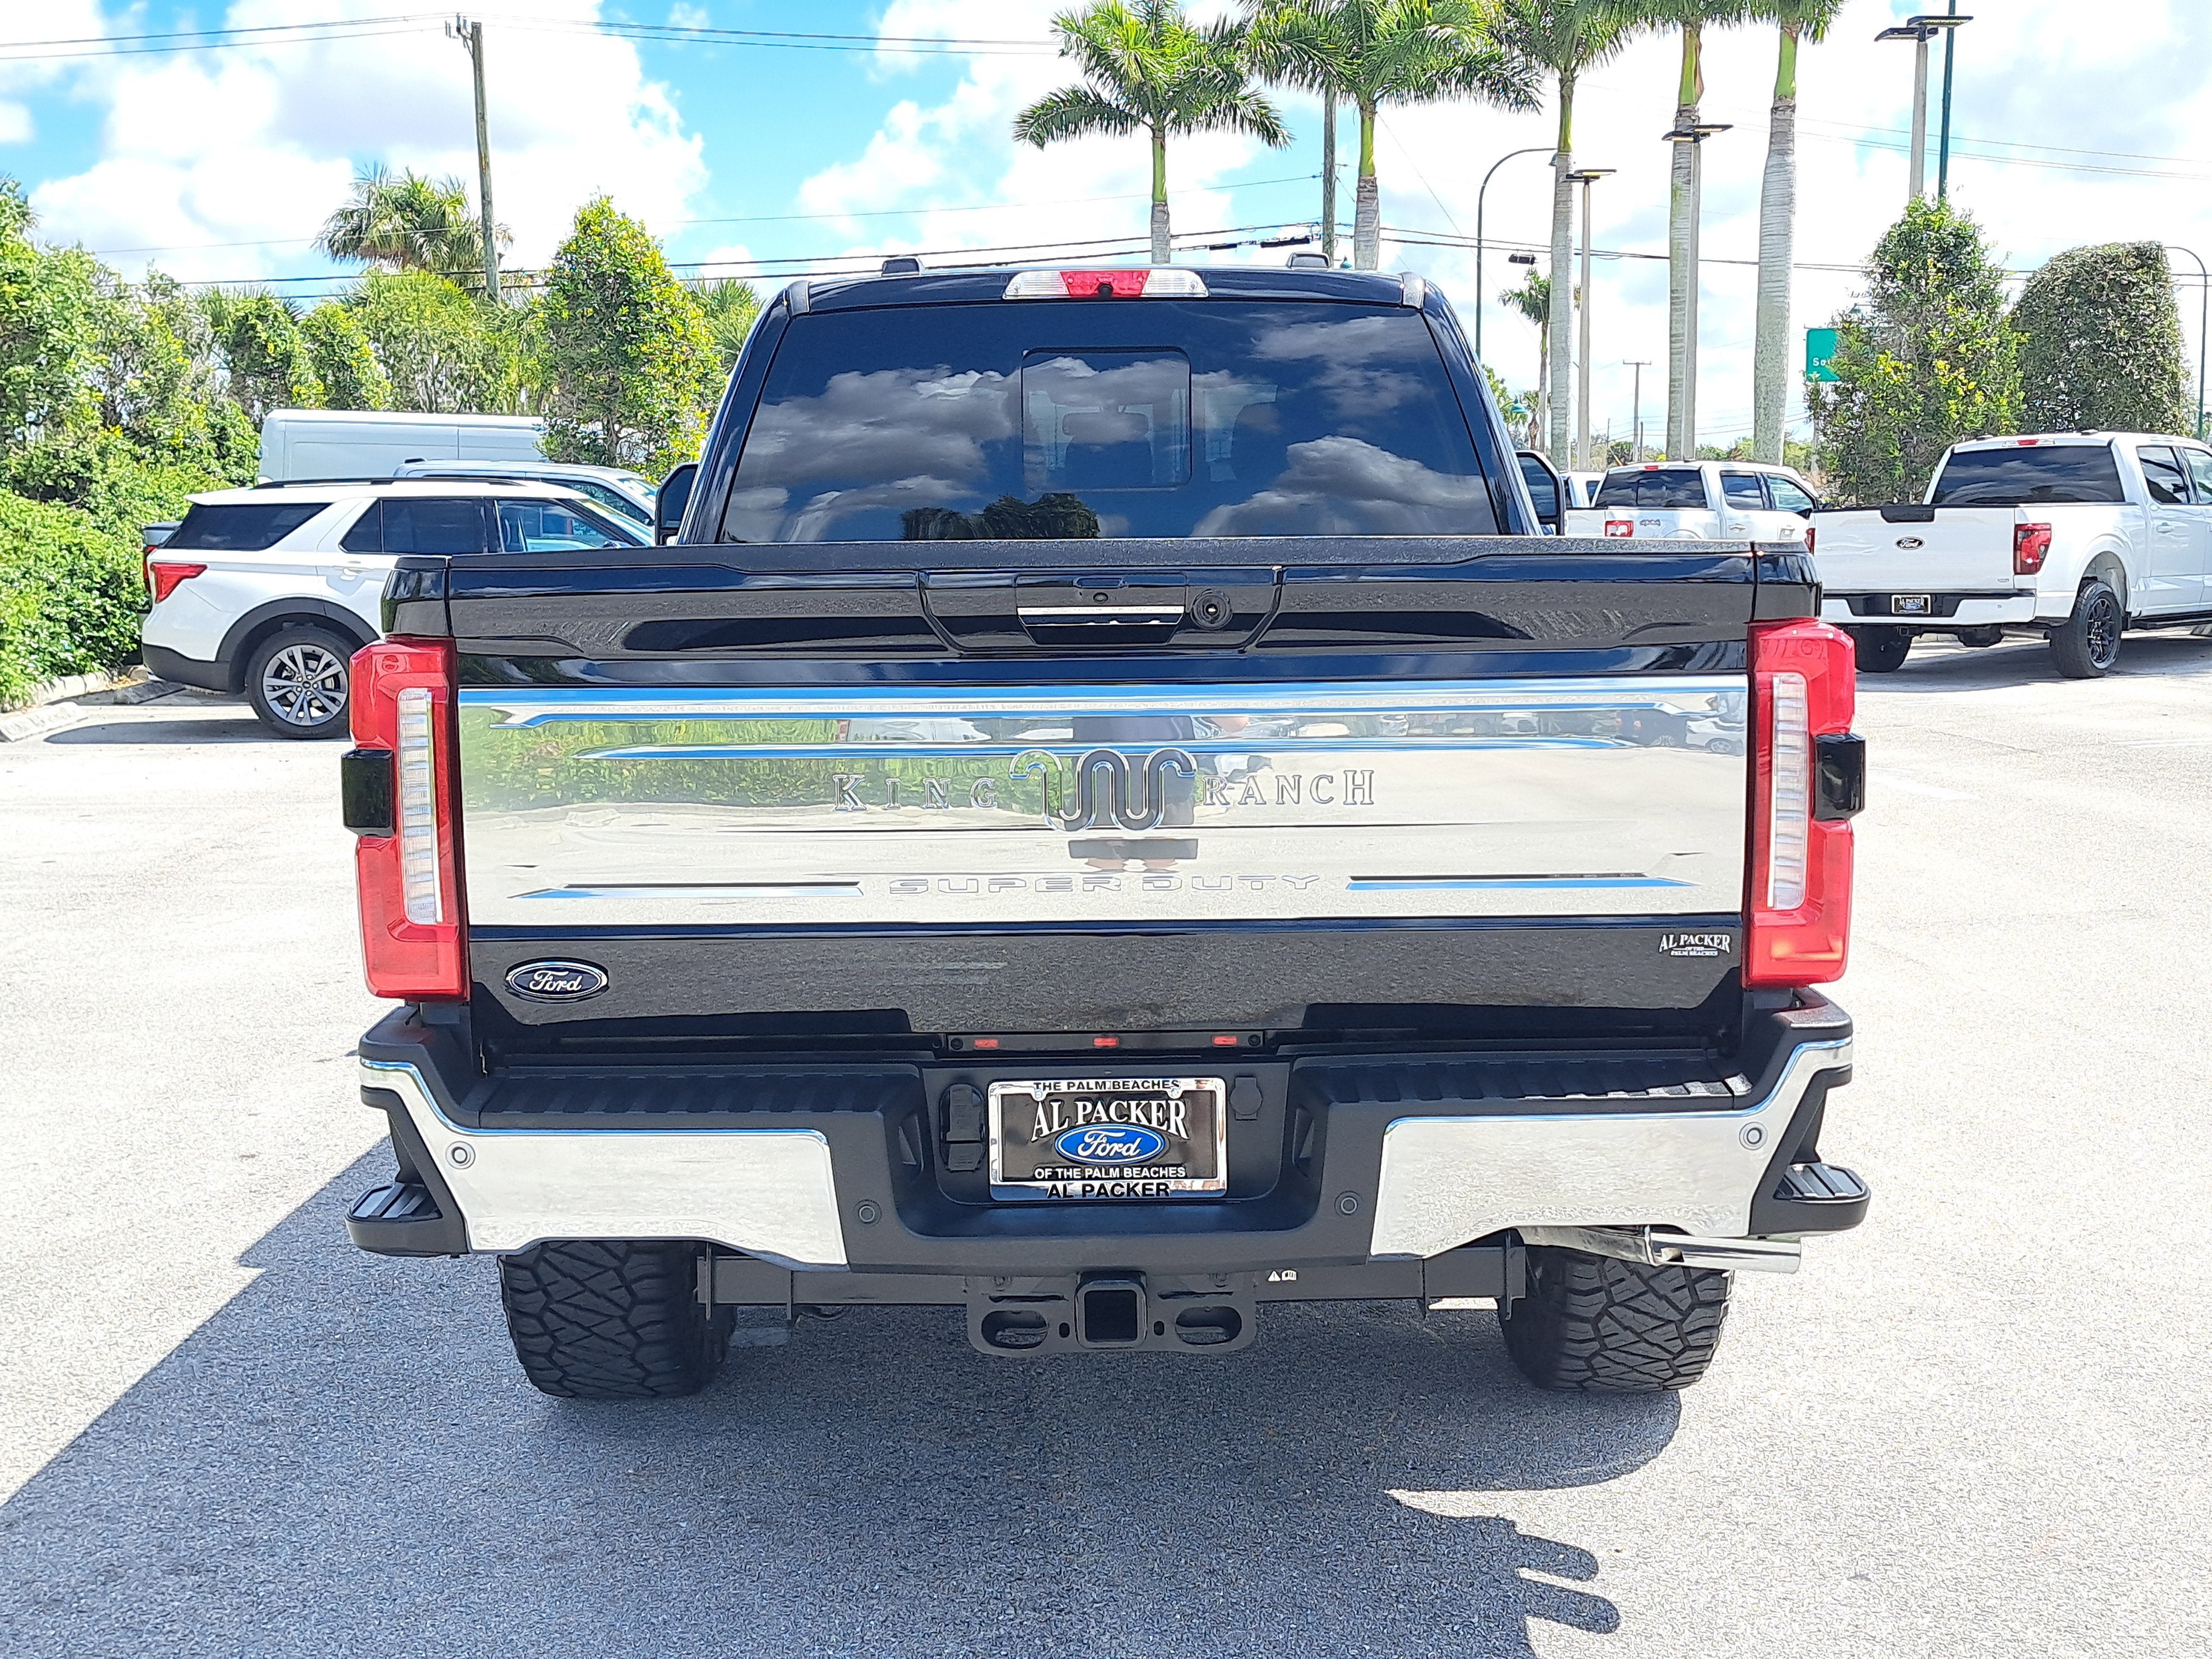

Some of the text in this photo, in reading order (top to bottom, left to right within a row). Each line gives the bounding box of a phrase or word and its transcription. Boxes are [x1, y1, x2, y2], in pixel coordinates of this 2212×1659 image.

[832, 770, 1374, 812] KING RANCH
[889, 875, 1319, 894] SUPER DUTY
[1658, 934, 1730, 954] AL PACKER
[529, 970, 583, 991] Ford
[1033, 1080, 1181, 1091] THE PALM BEACHES
[1030, 1100, 1190, 1142] AL PACKER
[1078, 1130, 1142, 1158] Ford
[1034, 1166, 1186, 1179] OF THE PALM BEACHES
[1047, 1182, 1171, 1198] AL PACKER
